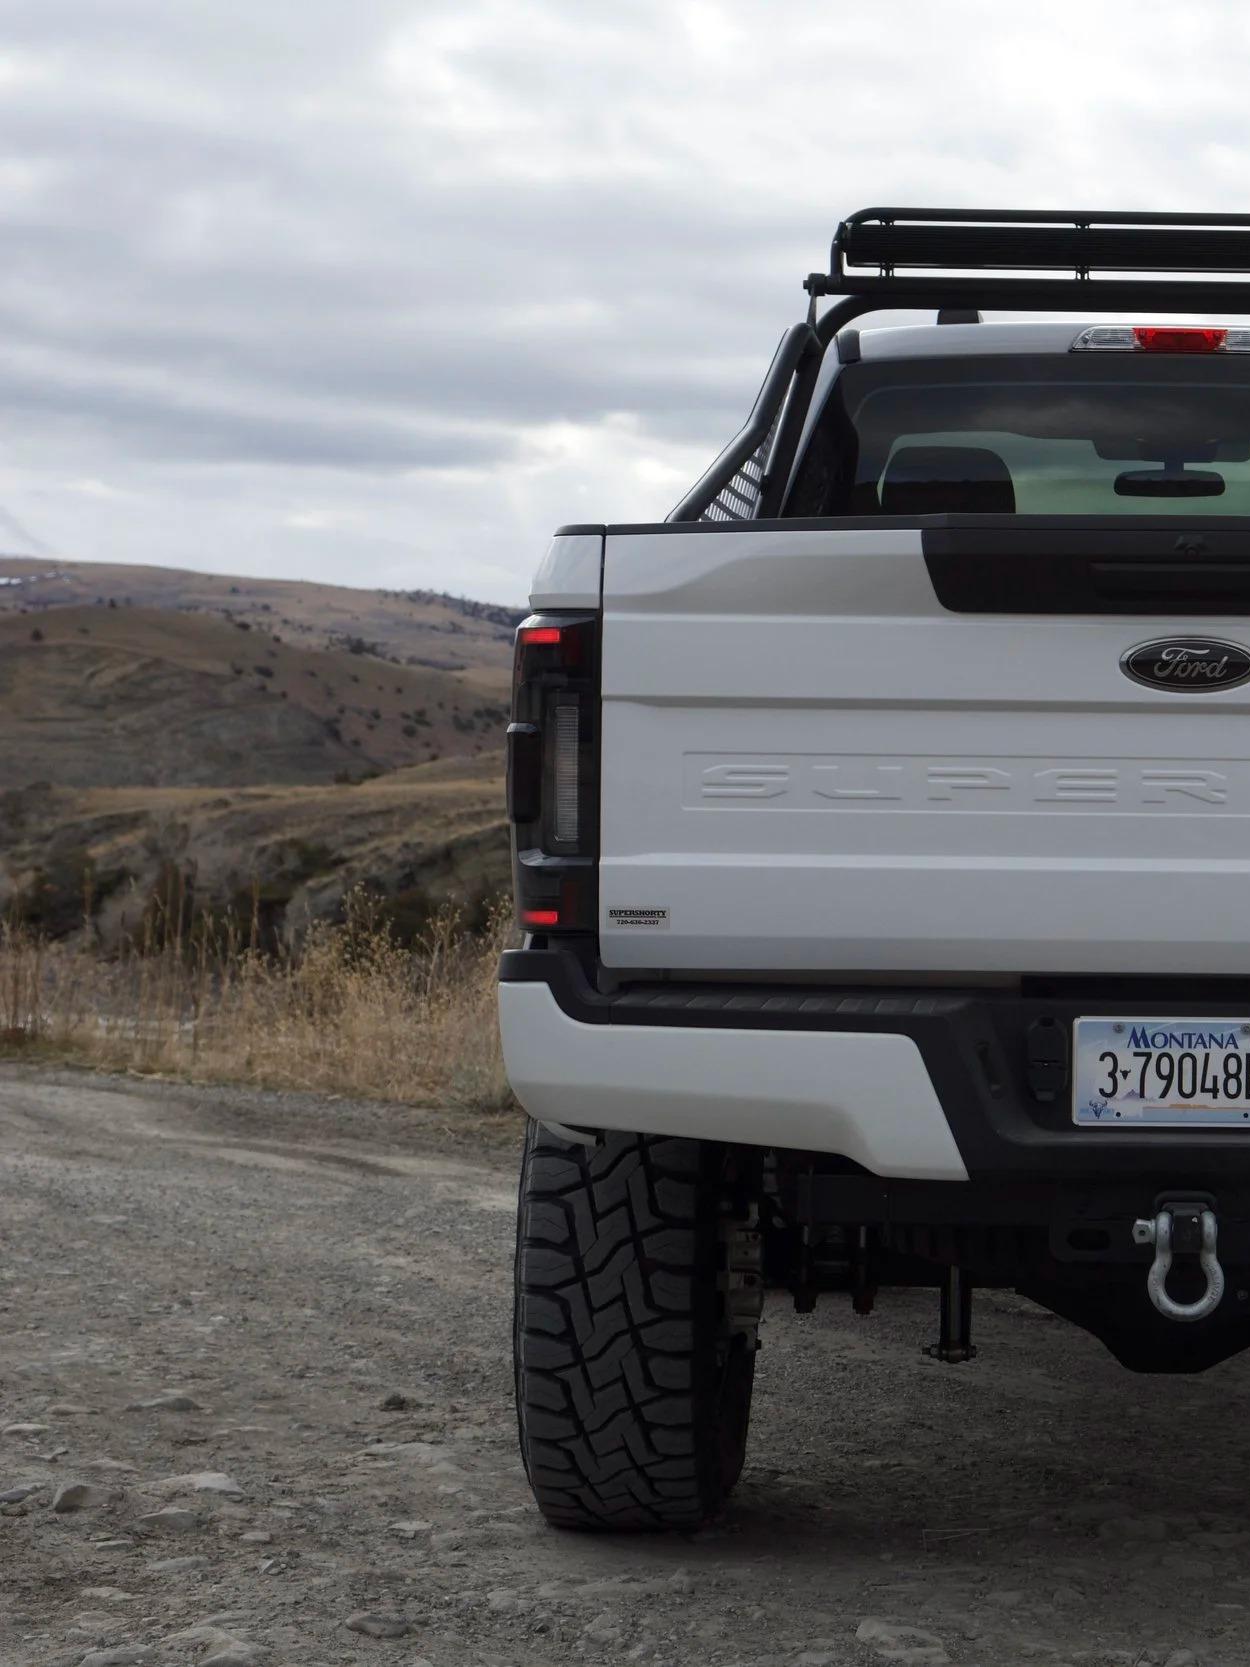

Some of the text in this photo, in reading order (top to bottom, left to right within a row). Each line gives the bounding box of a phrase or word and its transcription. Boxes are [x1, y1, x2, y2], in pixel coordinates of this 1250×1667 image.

[1154, 647, 1228, 678] Ford
[702, 763, 1226, 805] SUPER
[1127, 1026, 1239, 1050] MONTANA
